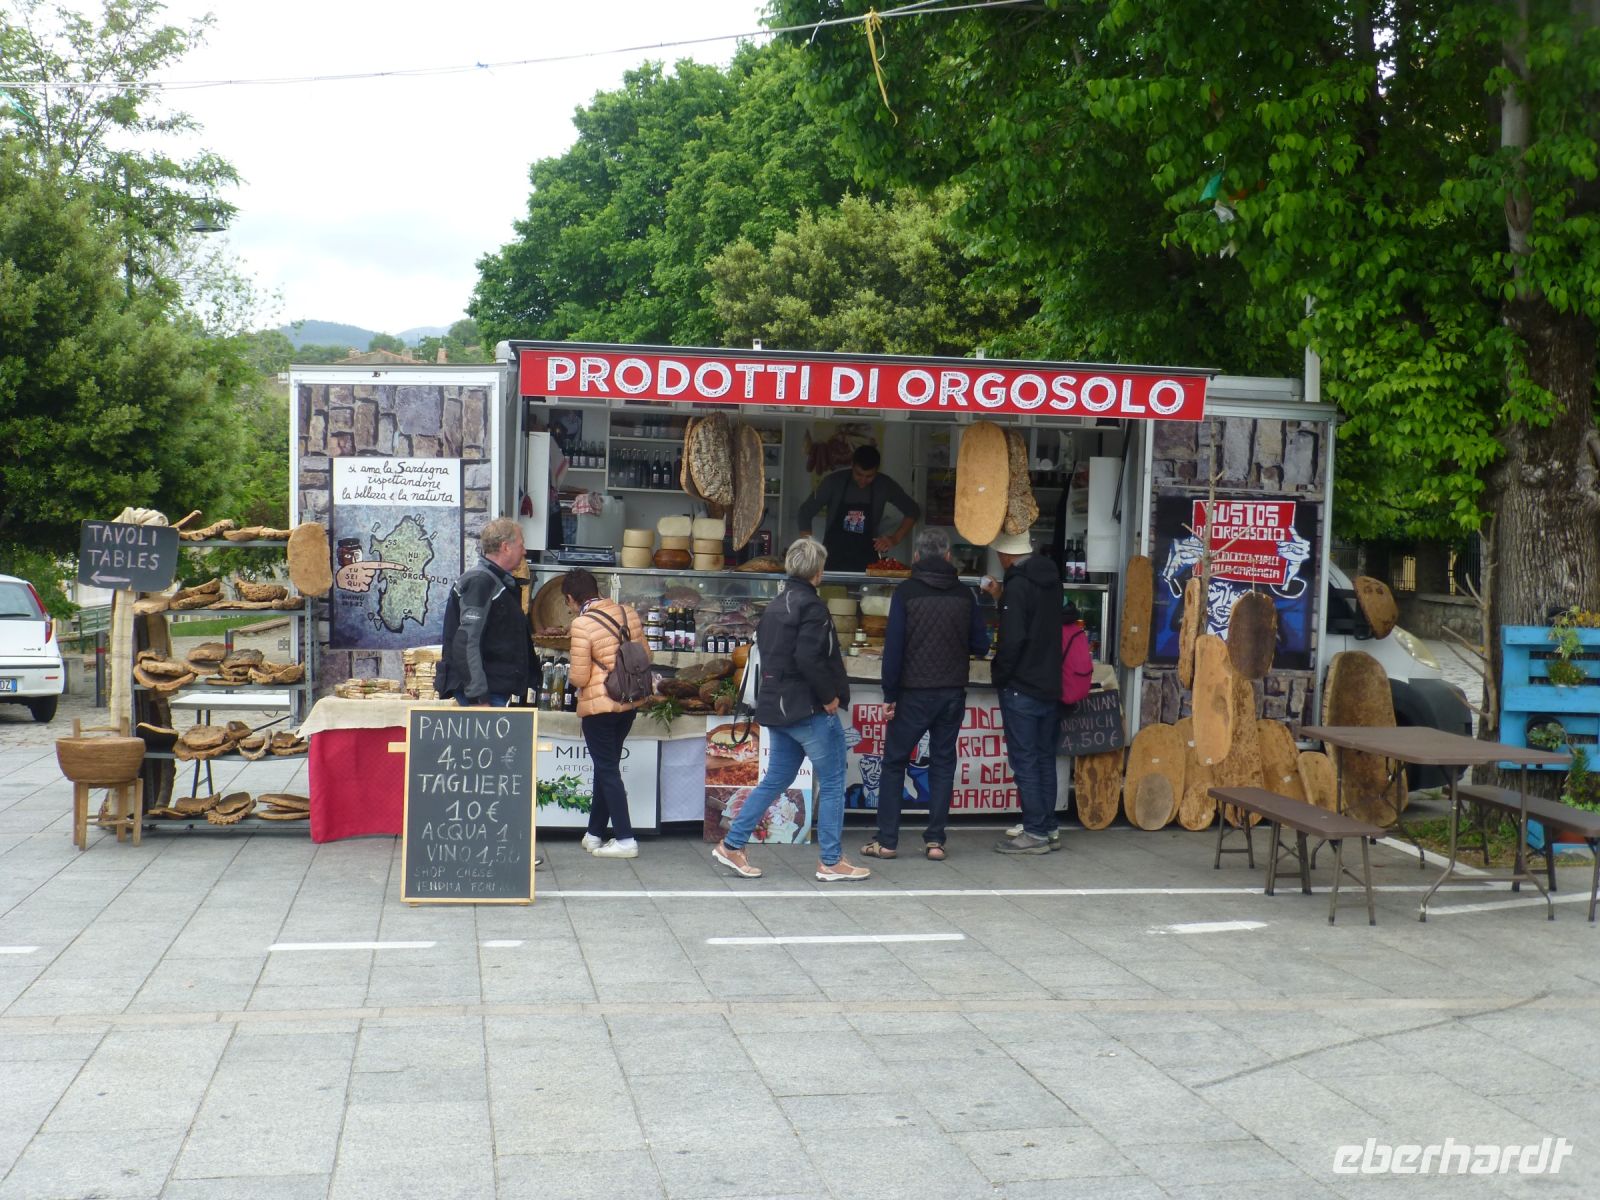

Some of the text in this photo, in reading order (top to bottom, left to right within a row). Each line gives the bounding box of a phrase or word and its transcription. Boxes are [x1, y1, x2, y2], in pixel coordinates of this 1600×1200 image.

[547, 356, 1185, 415] PRODOTTI DI ORGOSOLO
[397, 461, 449, 479] Sardegna
[411, 489, 454, 503] natura
[87, 524, 157, 547] TAVOLI
[1212, 526, 1285, 542] ORGOSOLO
[87, 549, 160, 571] TABLES
[402, 572, 448, 585] ORGOSOLO
[418, 715, 511, 741] PANINO
[961, 762, 970, 785] E
[416, 772, 523, 797] TAGLIERE
[421, 821, 488, 841] ACQUA
[426, 843, 472, 863] VINO
